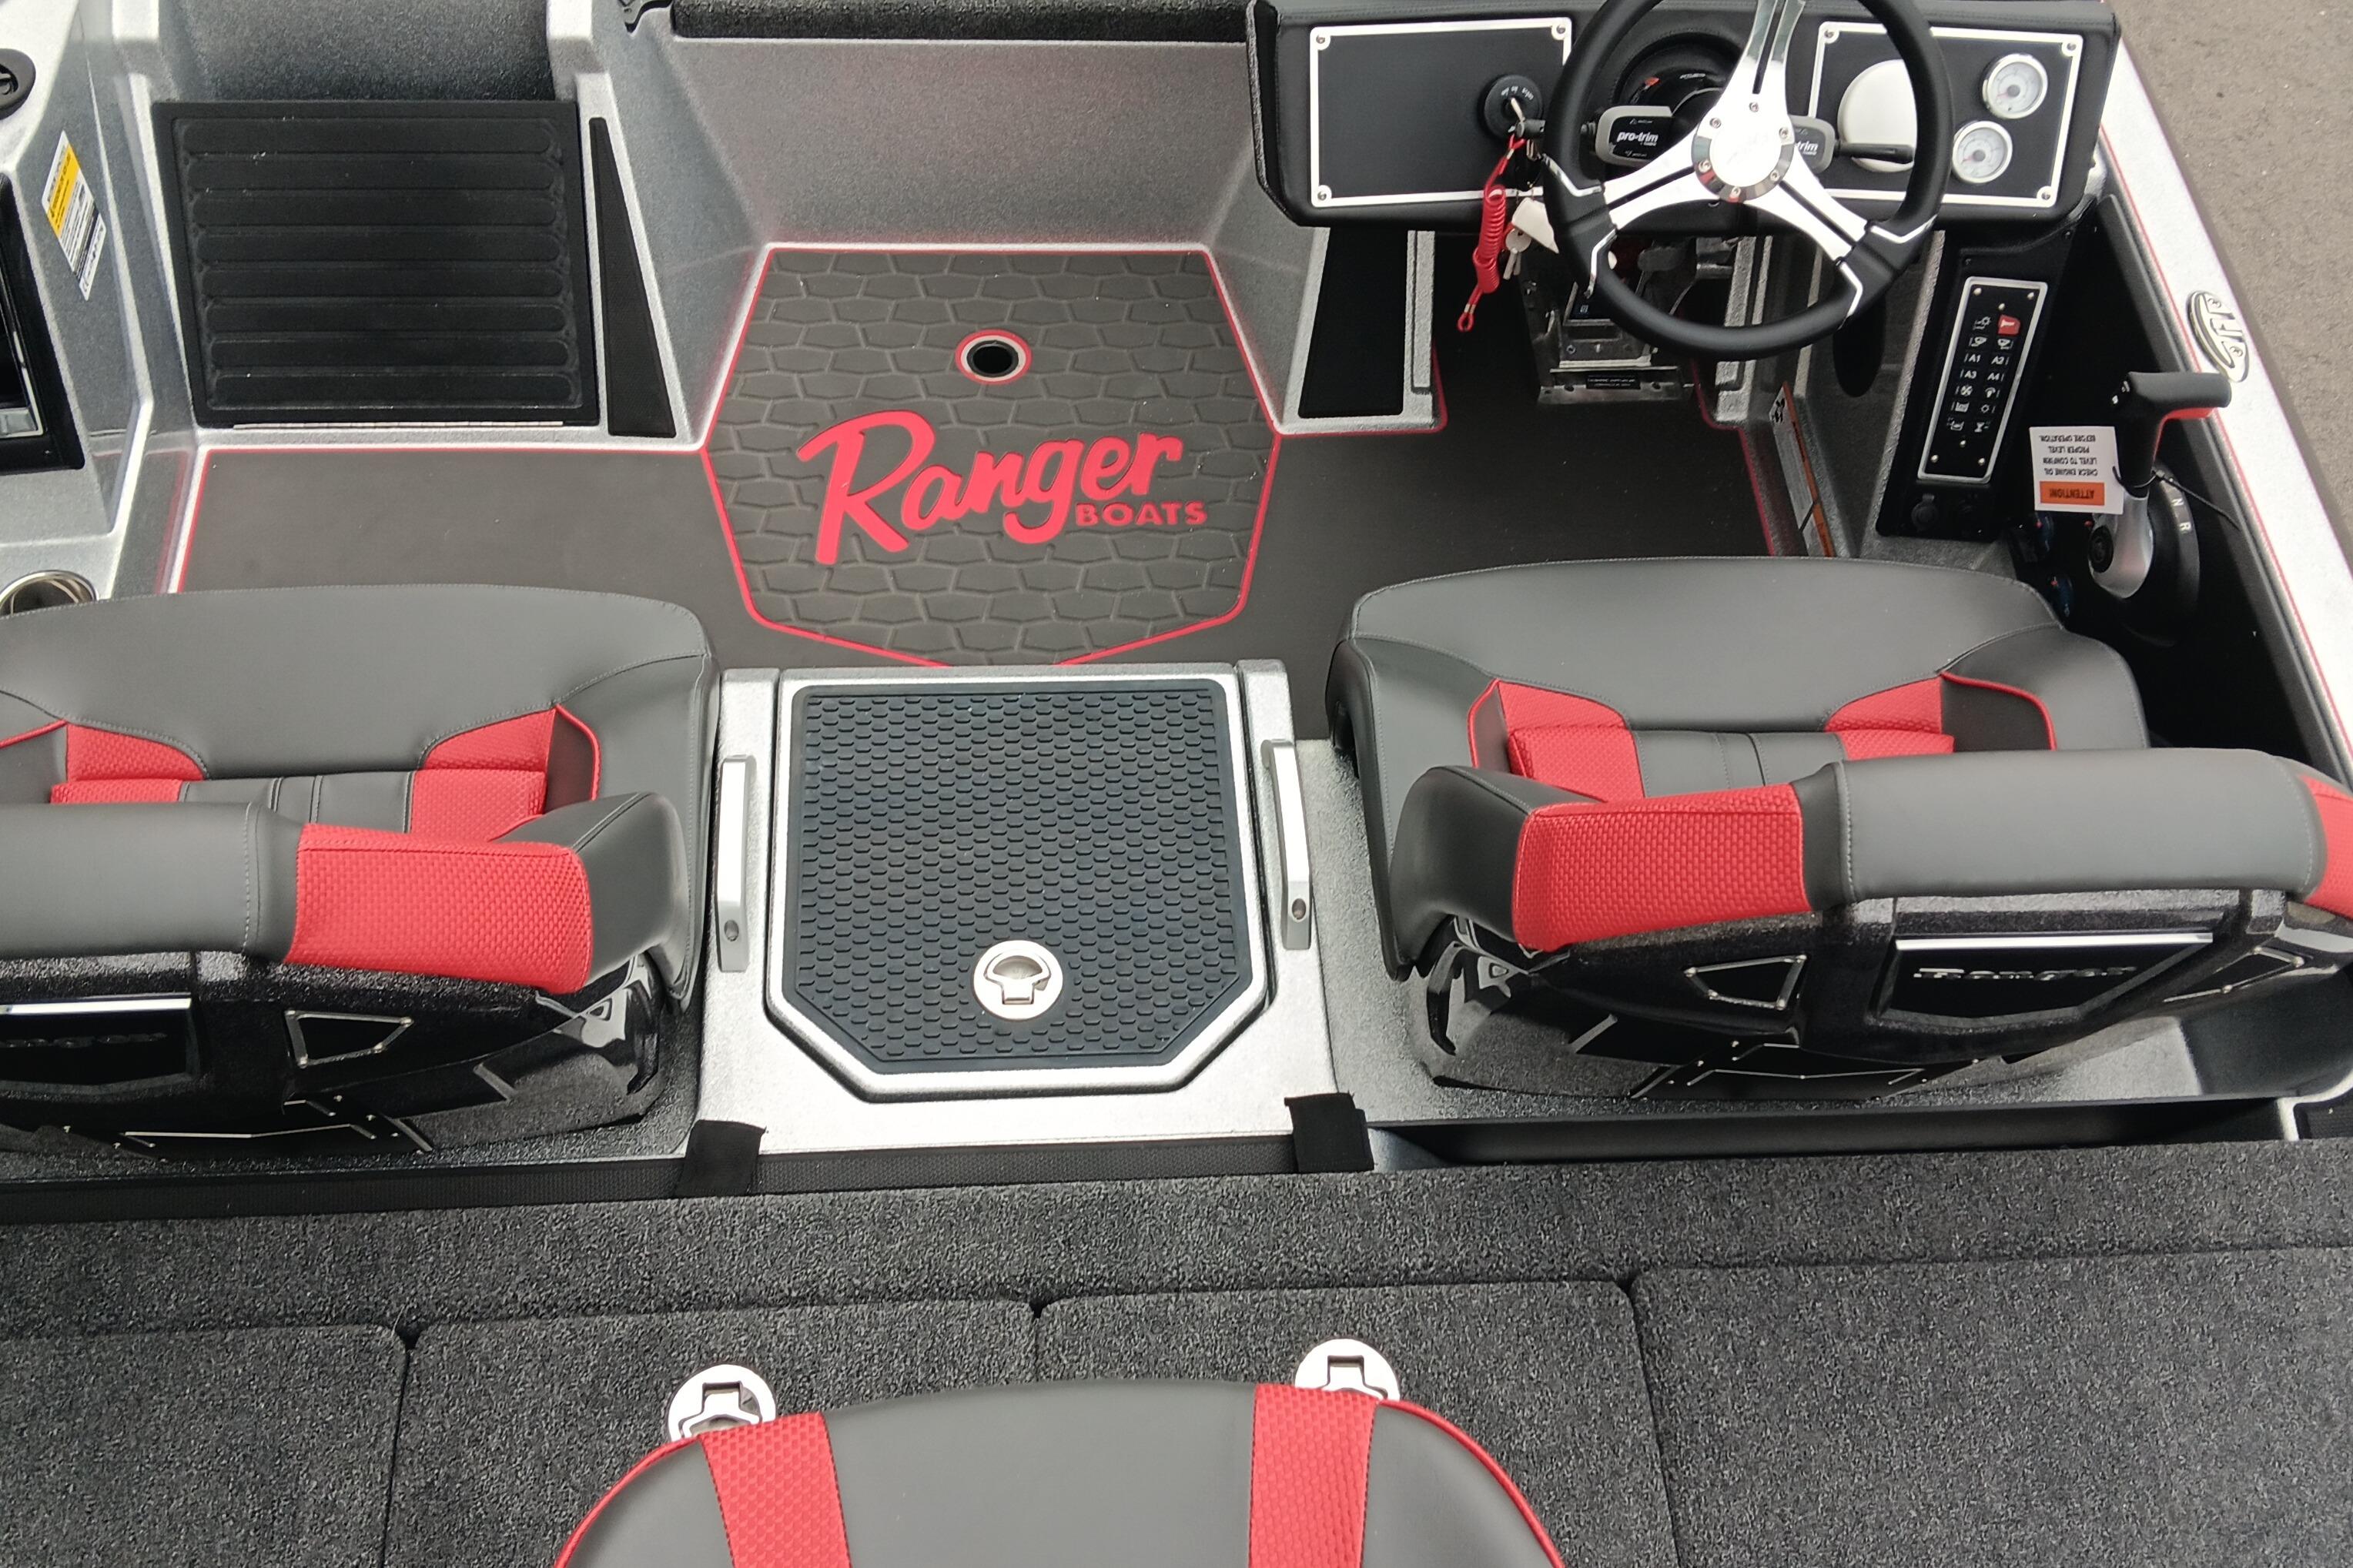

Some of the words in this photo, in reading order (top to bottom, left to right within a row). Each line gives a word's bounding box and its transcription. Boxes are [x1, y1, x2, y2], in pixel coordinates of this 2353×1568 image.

[1617, 132, 1658, 142] pro-trim
[1796, 140, 1819, 152] trim
[1968, 354, 1981, 363] A1
[1990, 356, 2005, 365] A2
[1964, 370, 1977, 379] A3
[2078, 468, 2098, 476] CHECK
[797, 410, 1183, 565] Ranger
[2049, 488, 2094, 500] ATTENTION!
[1076, 501, 1208, 527] BOATS
